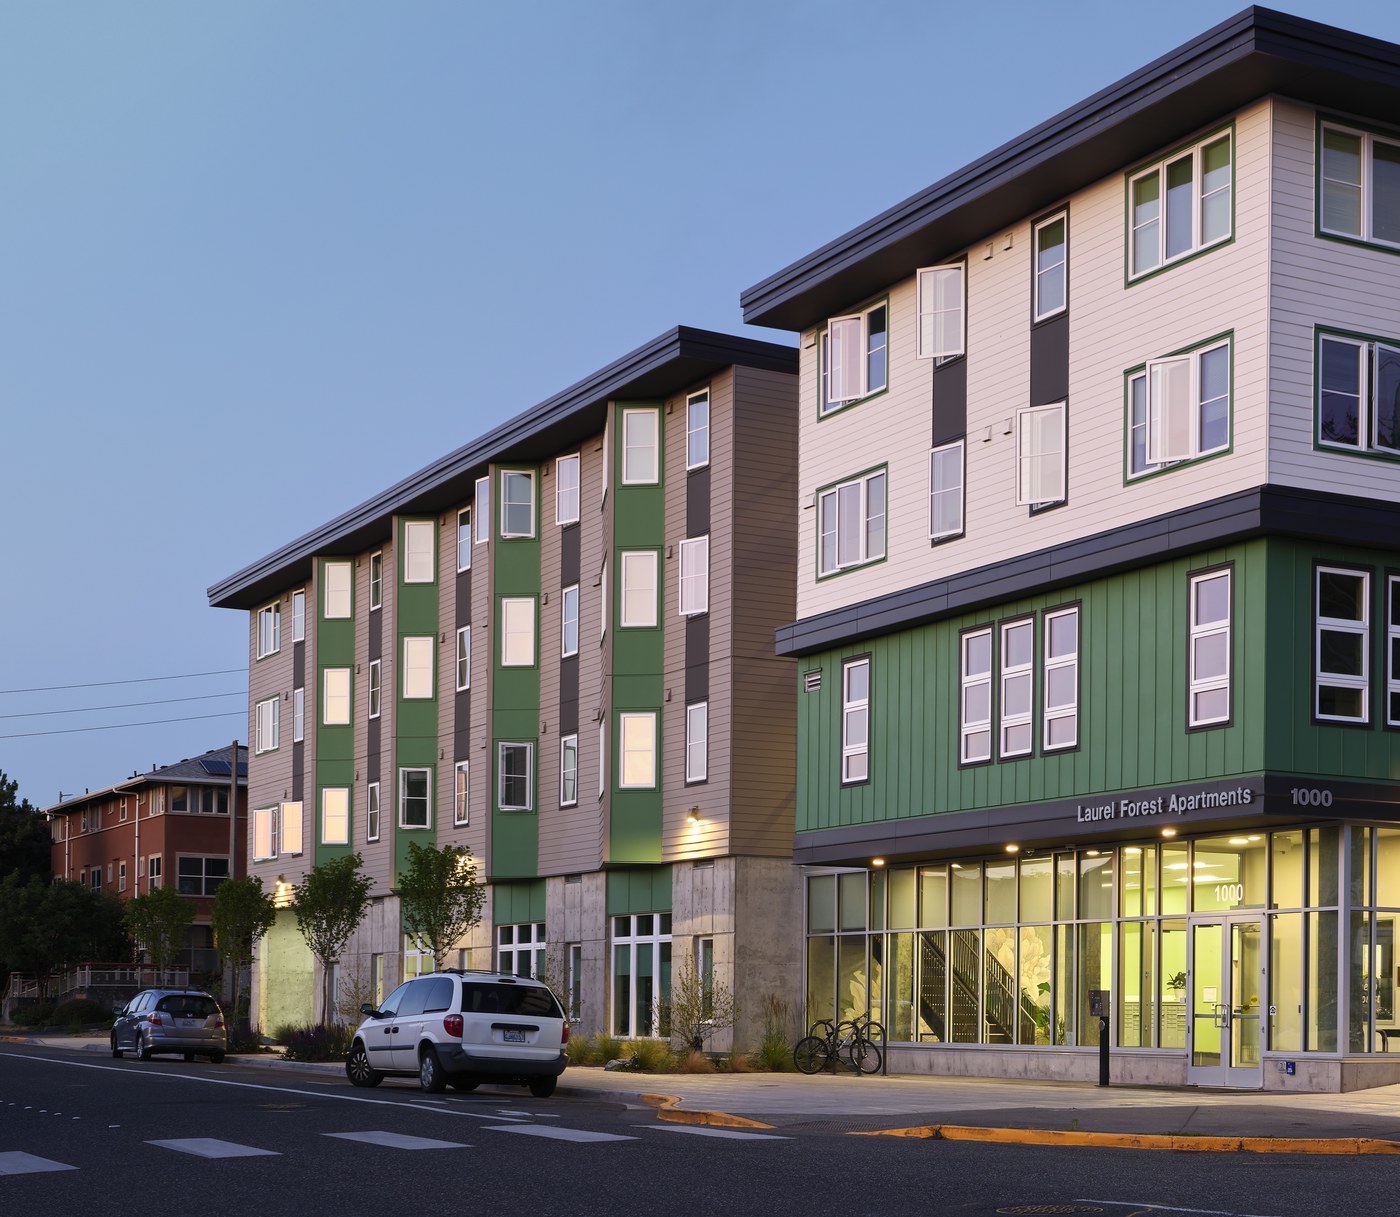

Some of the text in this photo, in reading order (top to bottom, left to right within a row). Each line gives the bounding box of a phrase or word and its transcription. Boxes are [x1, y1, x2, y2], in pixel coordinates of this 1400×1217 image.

[1077, 787, 1251, 823] Laurel Forest Apartments
[1291, 788, 1333, 807] 1000
[1214, 883, 1243, 902] 1000
